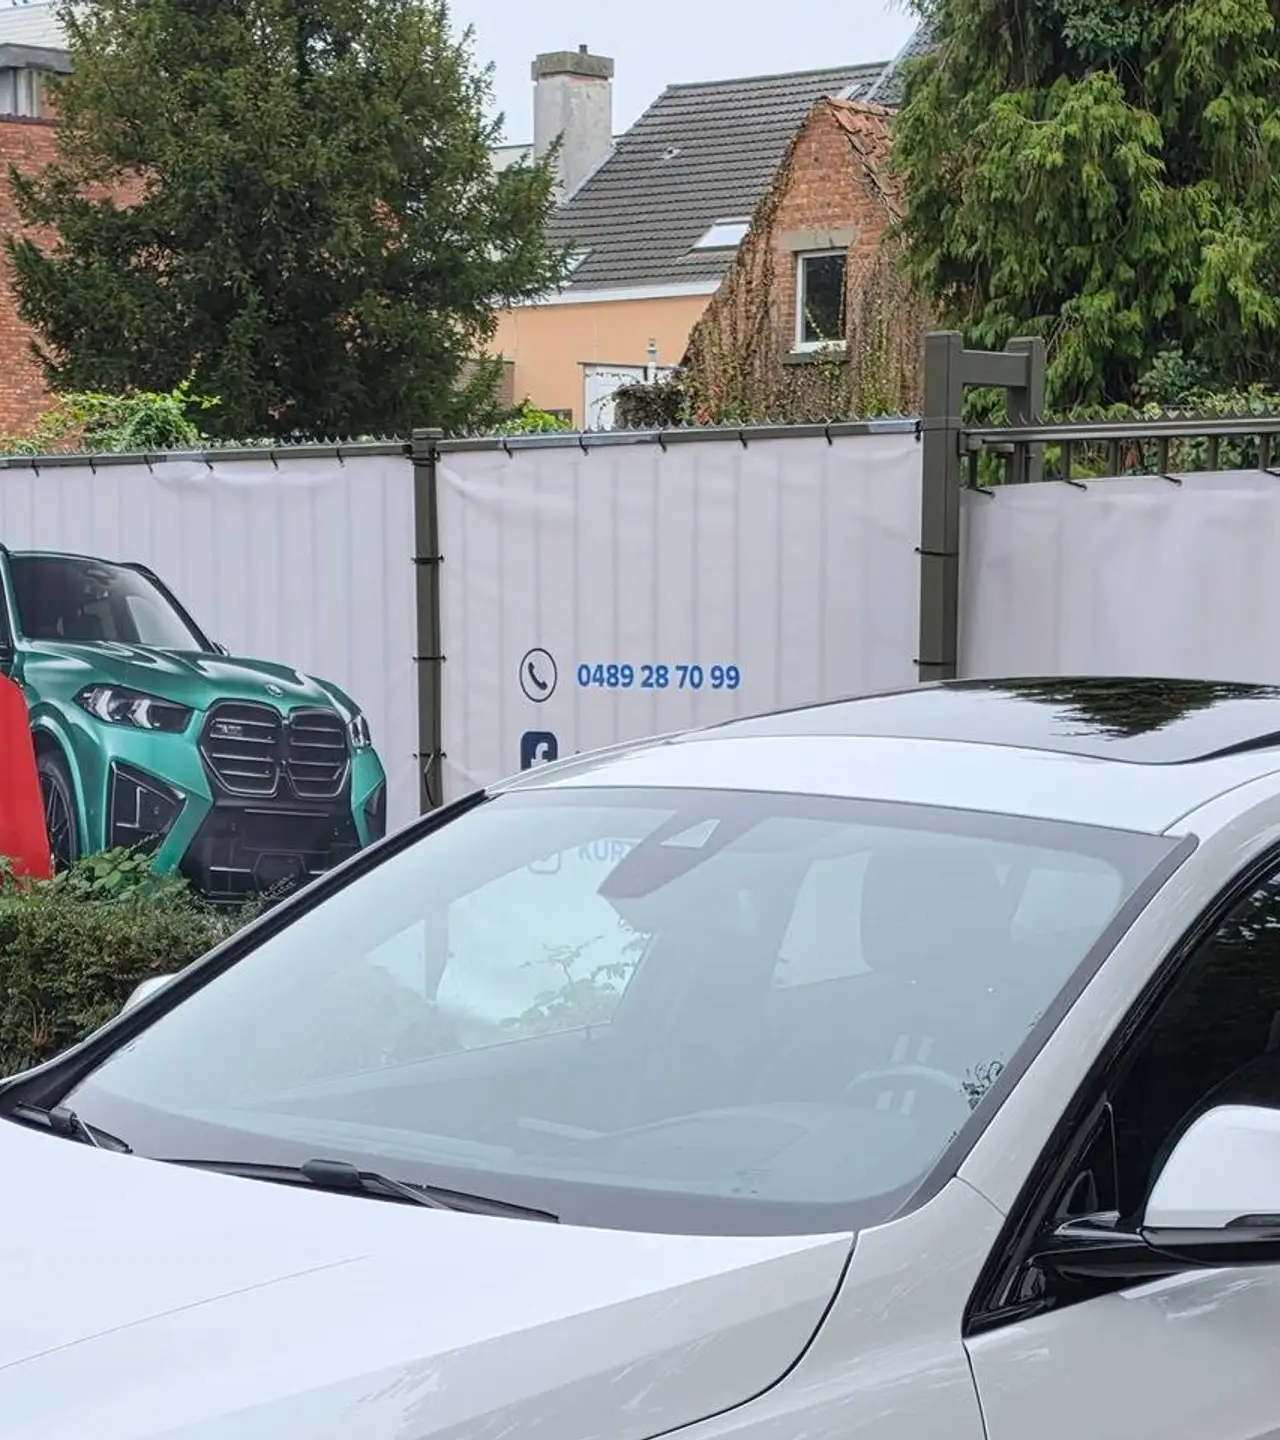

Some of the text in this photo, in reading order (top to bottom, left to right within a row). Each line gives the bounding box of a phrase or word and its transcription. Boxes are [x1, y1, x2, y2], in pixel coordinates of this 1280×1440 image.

[577, 663, 741, 690] 0489 28 70 99
